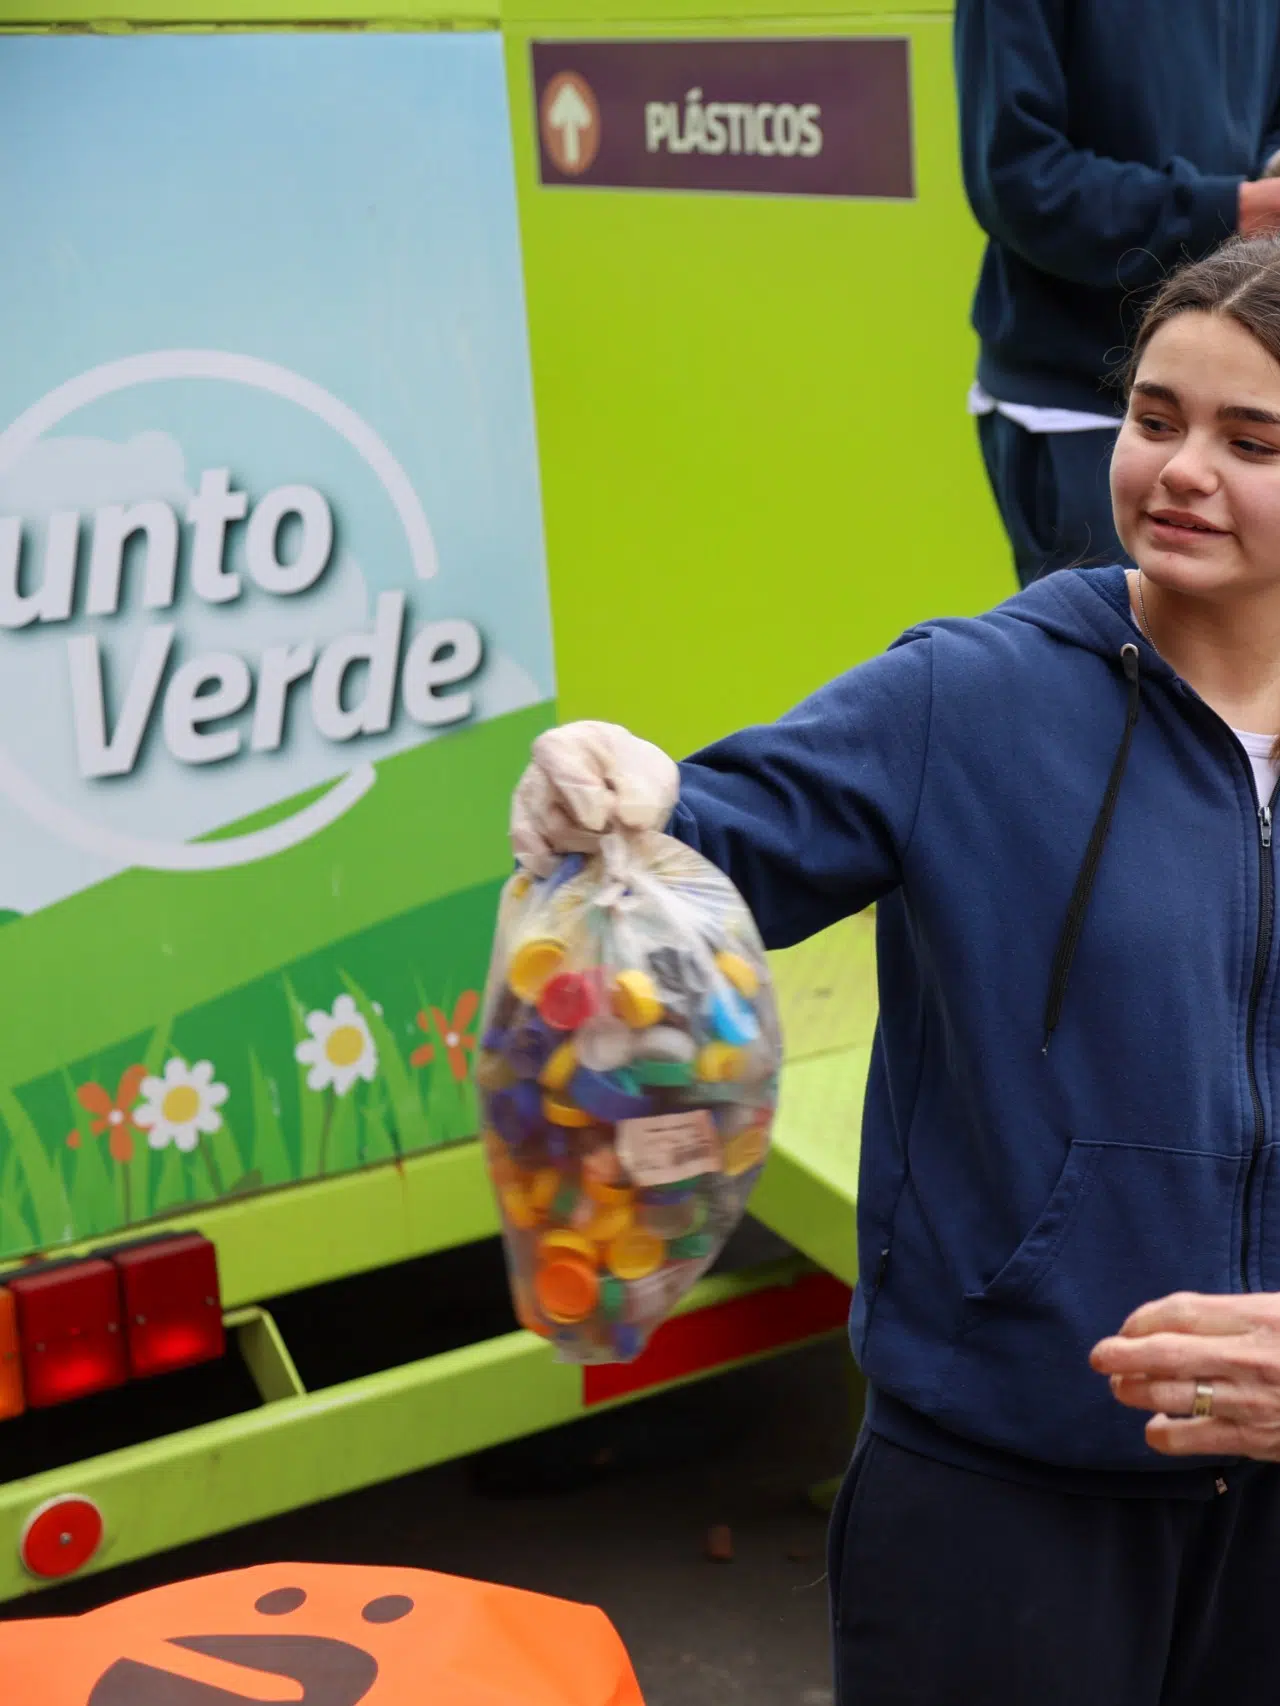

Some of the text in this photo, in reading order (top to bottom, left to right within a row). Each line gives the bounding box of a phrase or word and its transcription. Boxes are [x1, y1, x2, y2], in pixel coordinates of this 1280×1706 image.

[645, 86, 822, 157] PLÁSTICOS
[0, 466, 333, 629] unto
[66, 589, 483, 779] Verde
